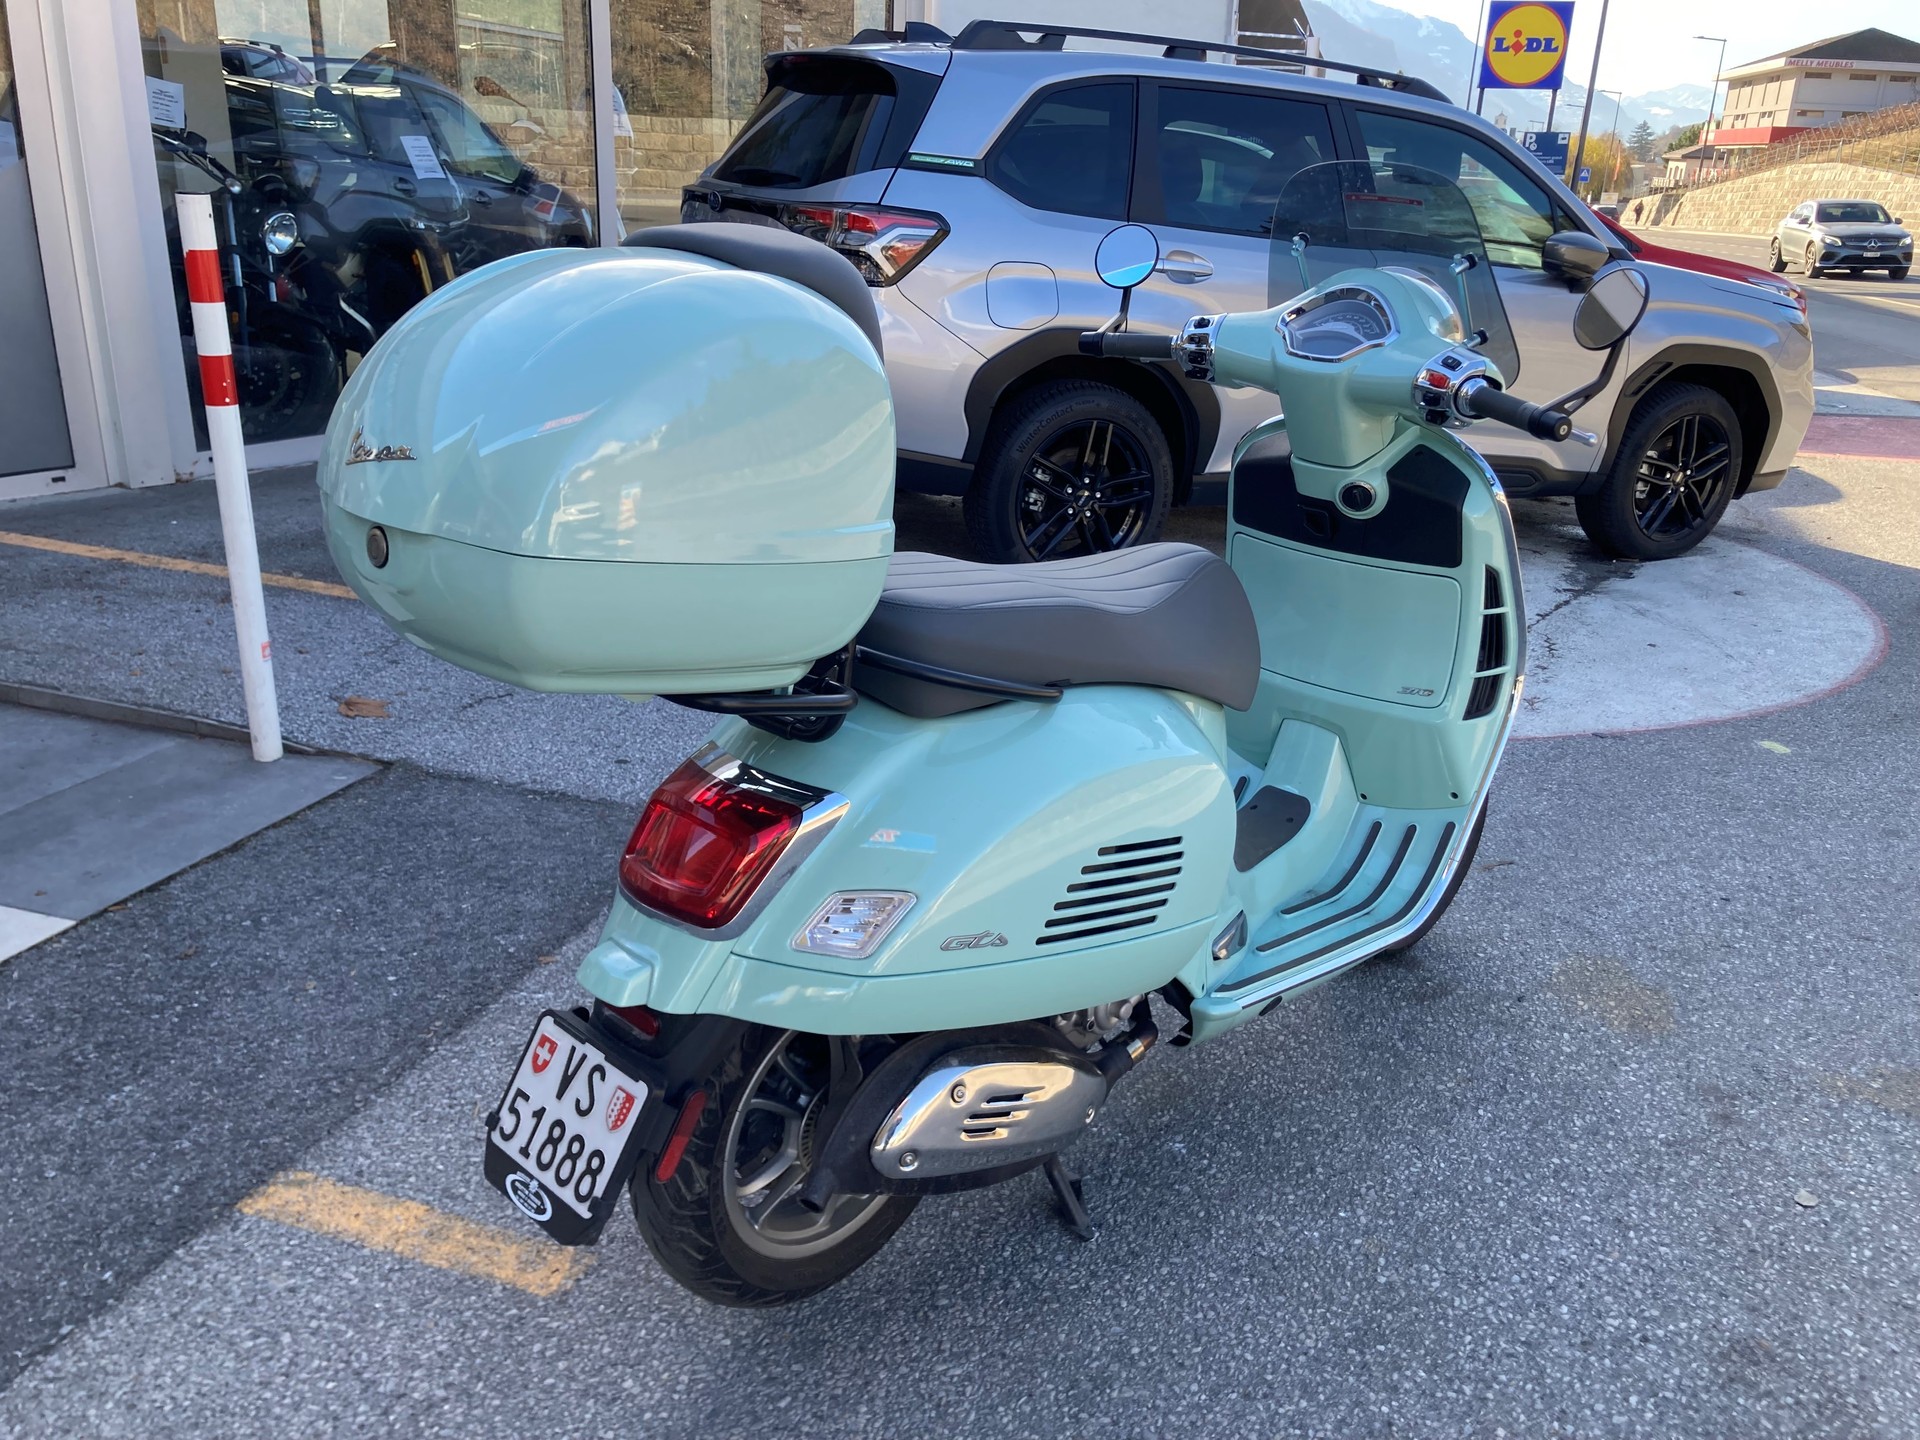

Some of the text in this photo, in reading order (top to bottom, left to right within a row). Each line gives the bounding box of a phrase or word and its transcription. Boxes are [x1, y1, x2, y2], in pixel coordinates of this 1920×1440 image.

[1788, 59, 1854, 68] MELLY MEUBLES
[1525, 133, 1536, 147] P
[1016, 404, 1074, 453] WinterContact
[556, 1045, 606, 1117] VS
[499, 1088, 606, 1203] 51888
